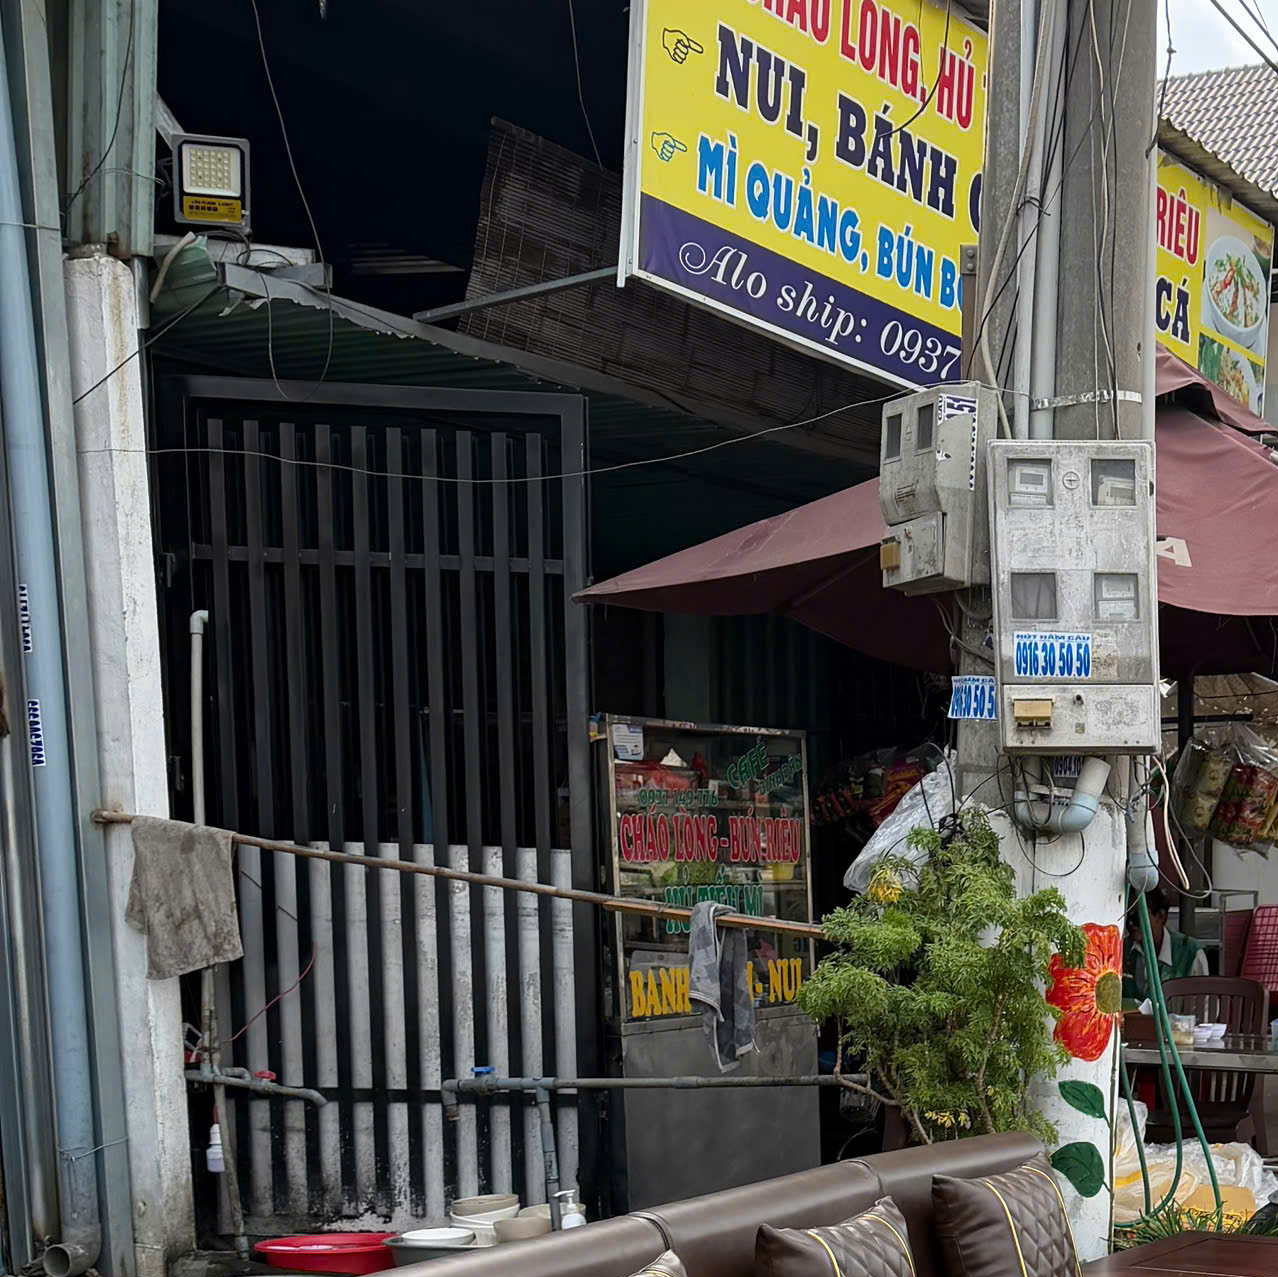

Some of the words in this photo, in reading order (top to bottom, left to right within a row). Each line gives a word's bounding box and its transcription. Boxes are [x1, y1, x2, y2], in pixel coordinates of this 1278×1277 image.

[717, 24, 819, 160] NUI,
[836, 93, 957, 217] BÁNH
[937, 40, 975, 129] HỦ
[697, 134, 737, 206] MÌ
[747, 168, 868, 272] QUẢNG,
[877, 225, 933, 299] BÚN
[679, 242, 766, 299] Alo
[777, 280, 866, 345] ship:
[881, 320, 961, 380] 0937
[1156, 277, 1189, 344] CÁ
[620, 803, 670, 863] CHÁO
